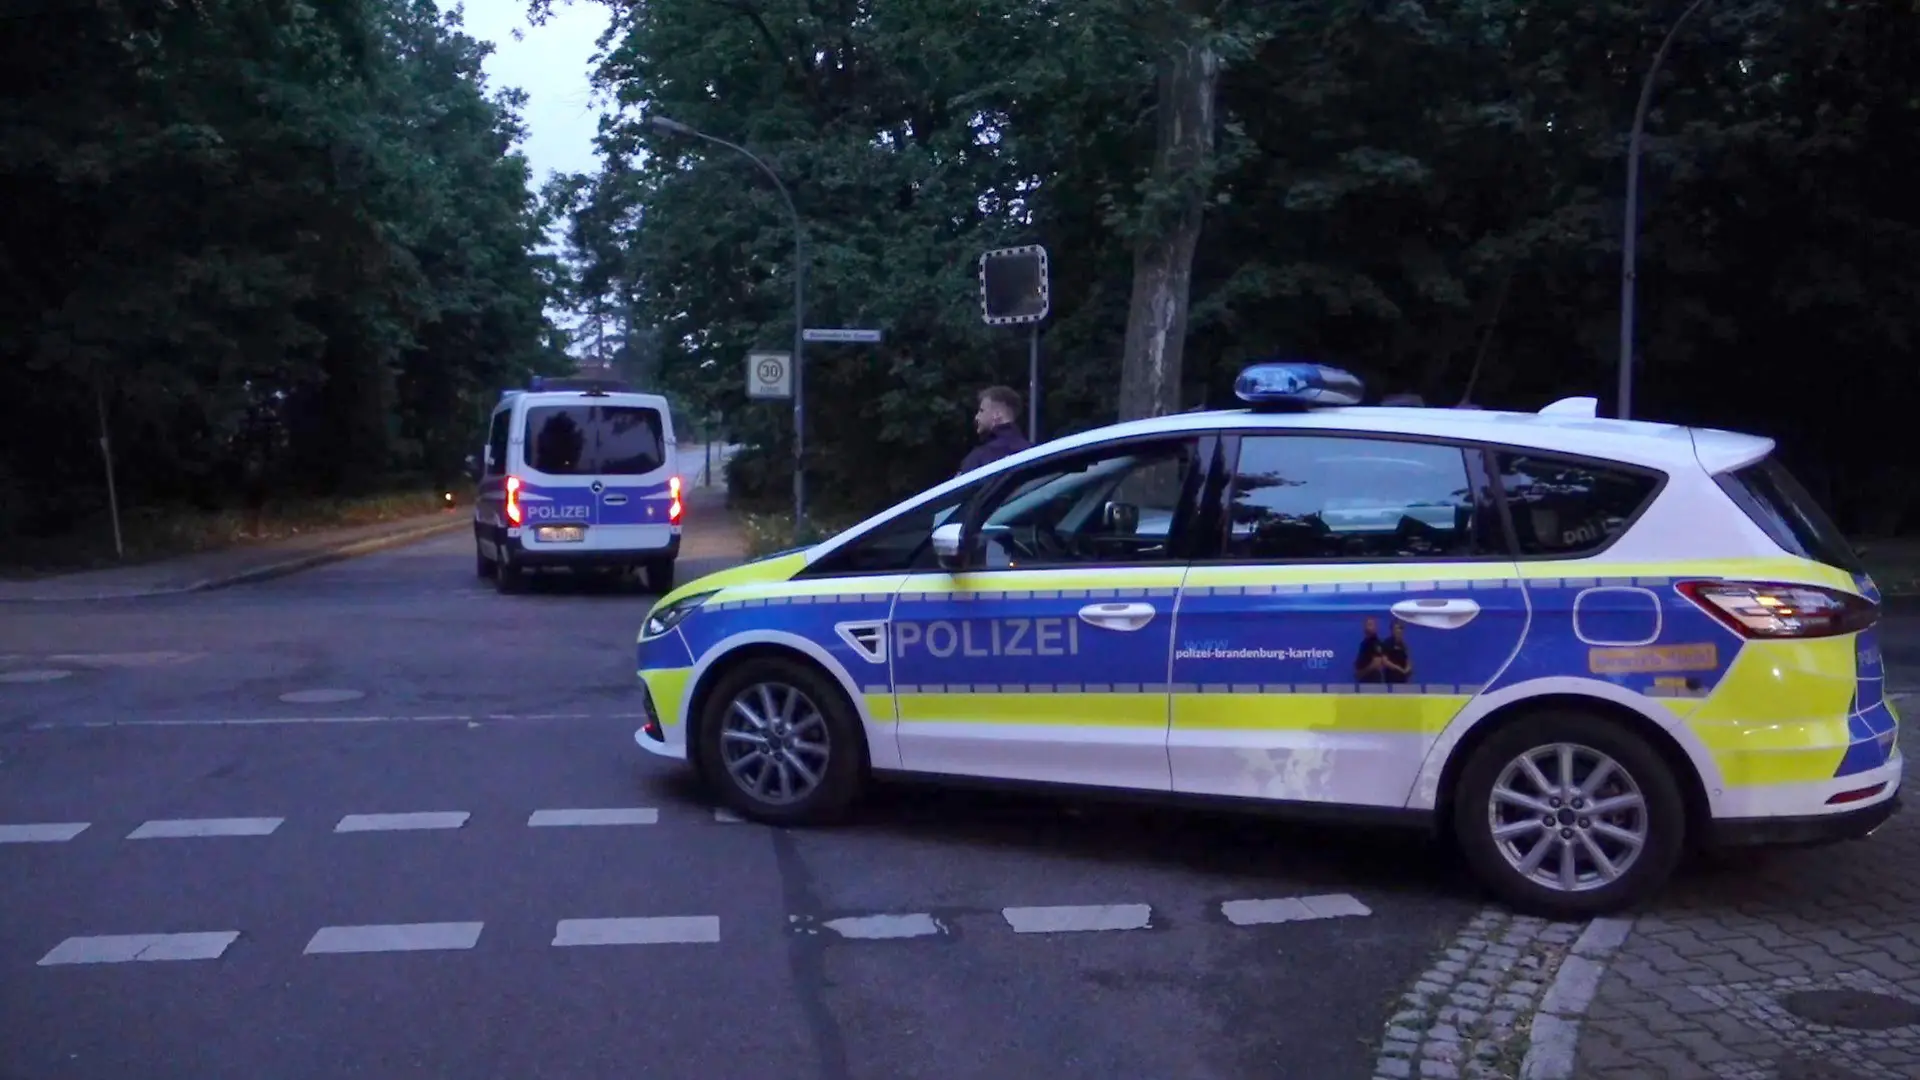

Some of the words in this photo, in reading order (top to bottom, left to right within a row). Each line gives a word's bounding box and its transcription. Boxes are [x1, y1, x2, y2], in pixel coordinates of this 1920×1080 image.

[761, 364, 778, 378] 30
[527, 505, 590, 519] POLIZEI
[895, 617, 1079, 658] POLIZEI
[1175, 647, 1334, 660] polizei-brandenburg-karriere
